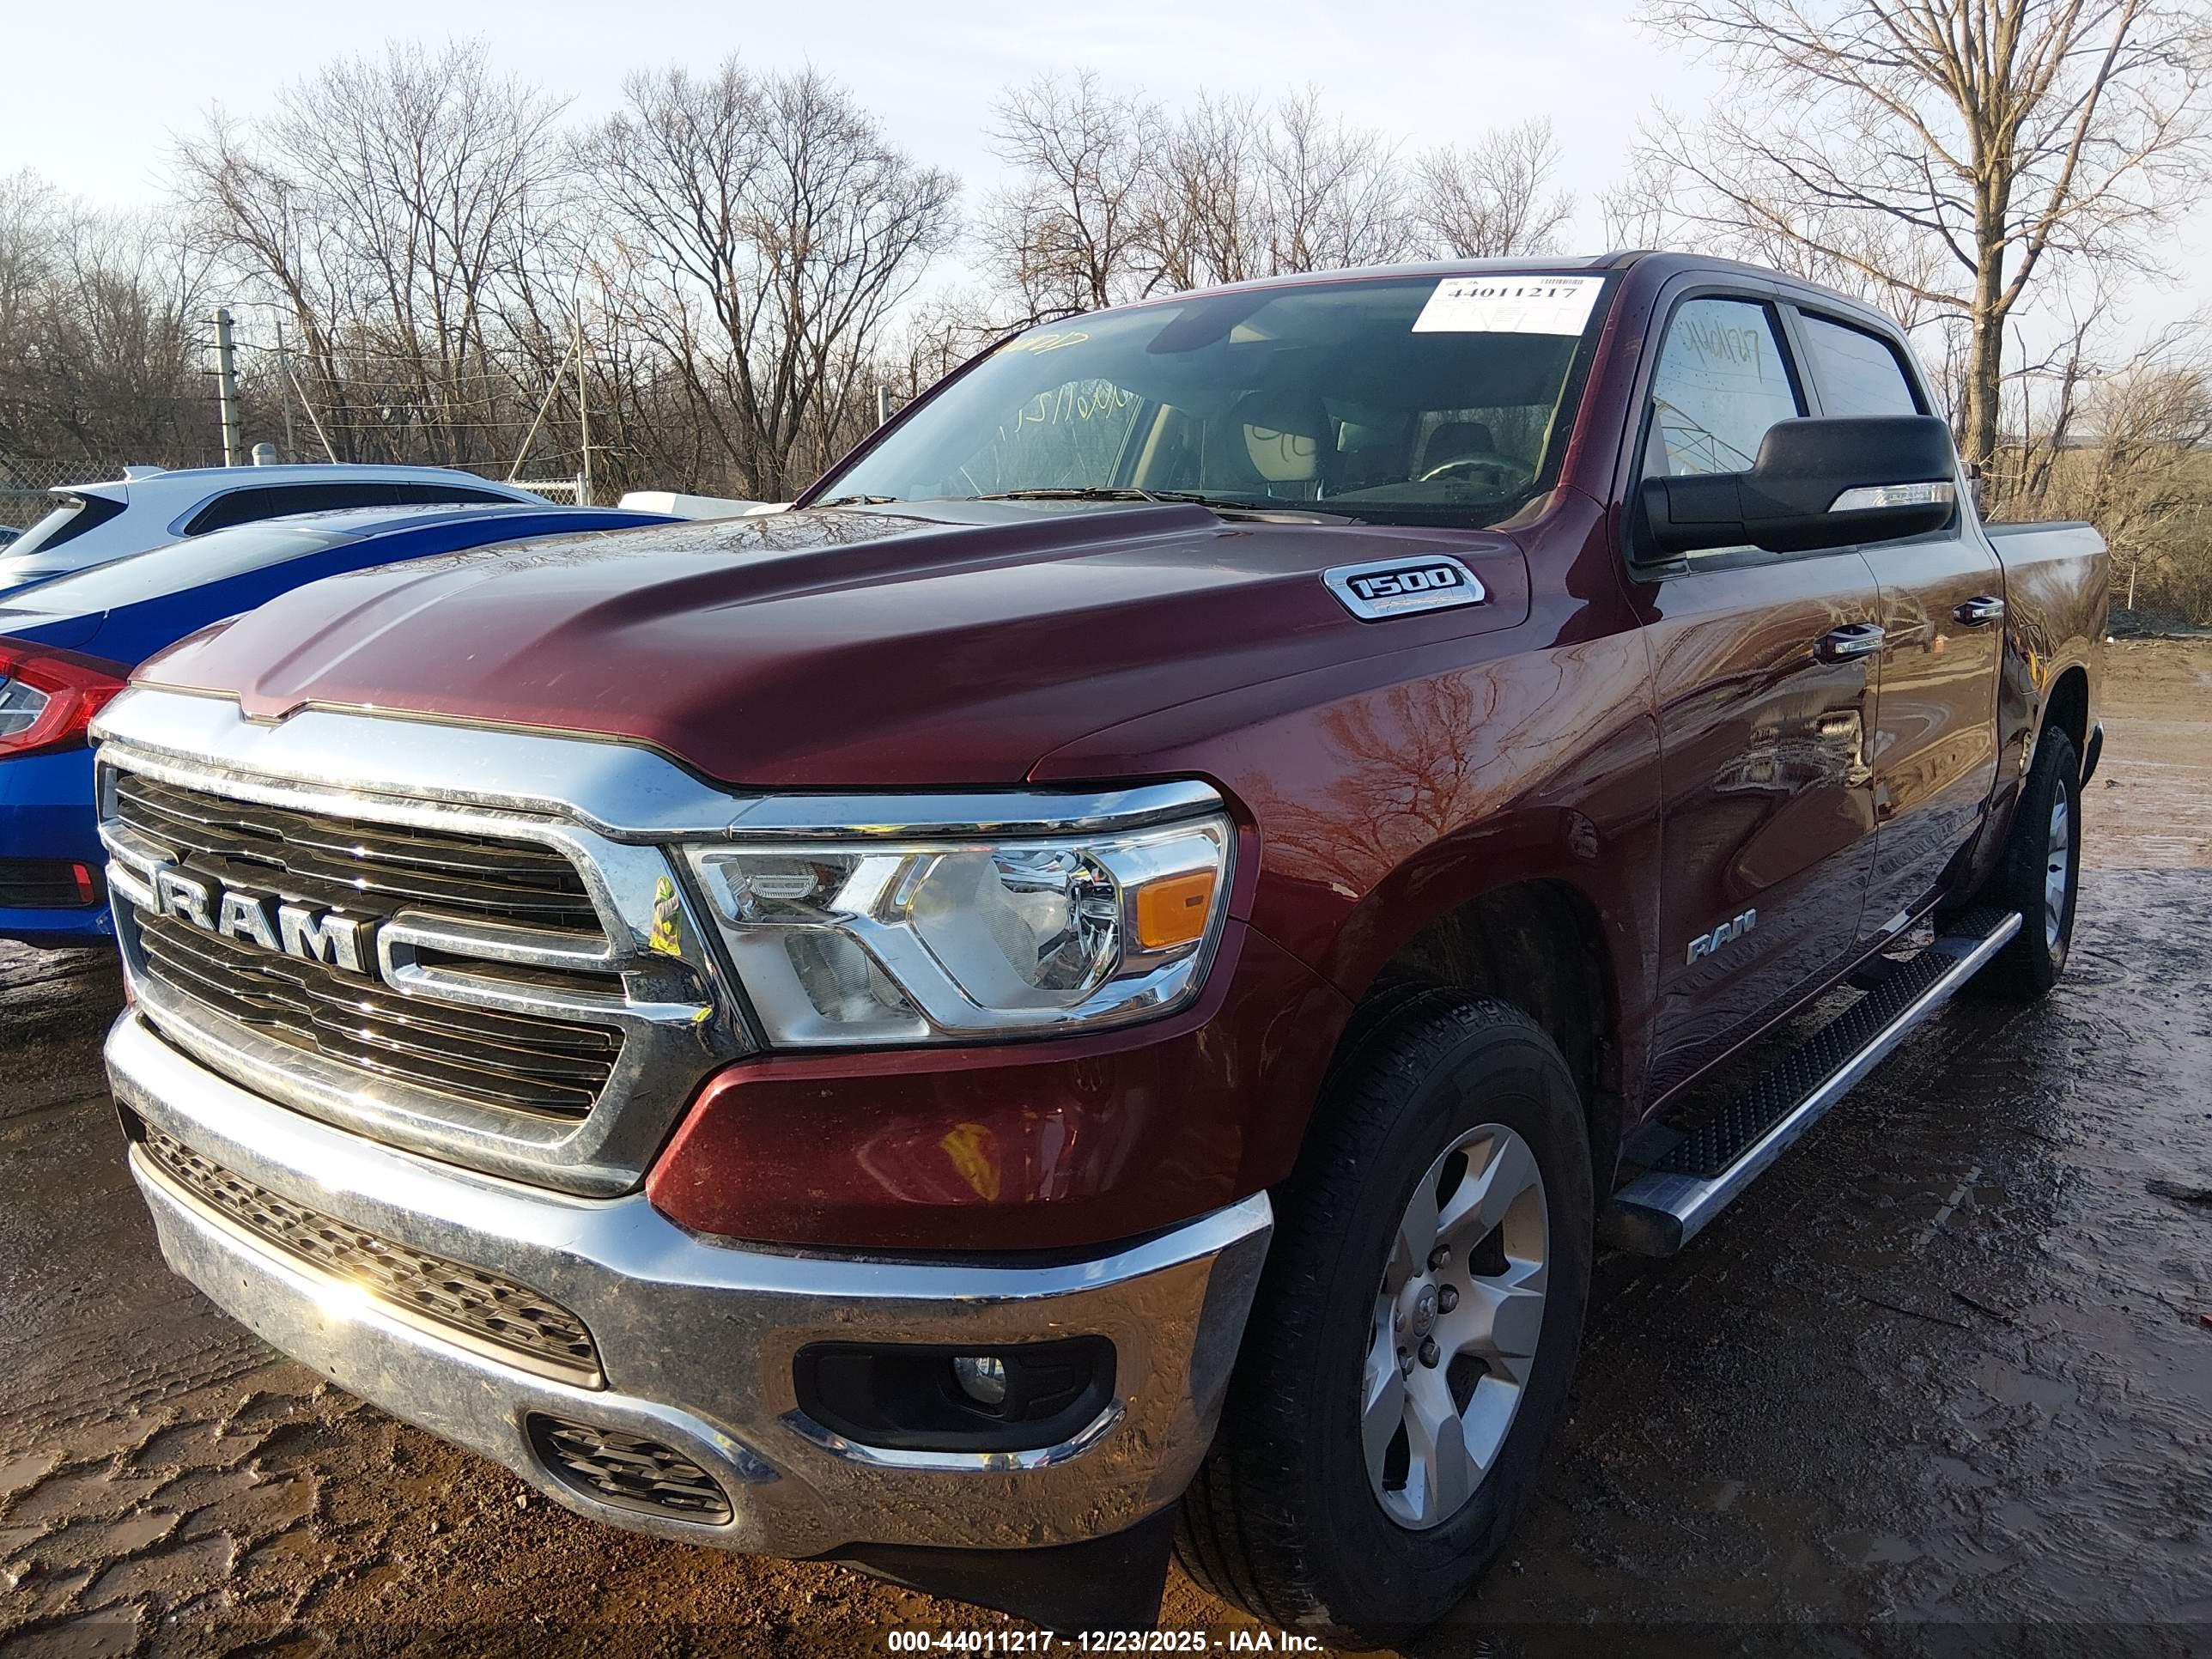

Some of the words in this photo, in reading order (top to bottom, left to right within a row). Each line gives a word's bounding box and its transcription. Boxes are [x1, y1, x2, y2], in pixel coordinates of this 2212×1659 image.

[1447, 288, 1578, 299] 44011217
[1351, 567, 1457, 599] 1500
[158, 869, 369, 975] RAM
[1686, 908, 1757, 966] RAM
